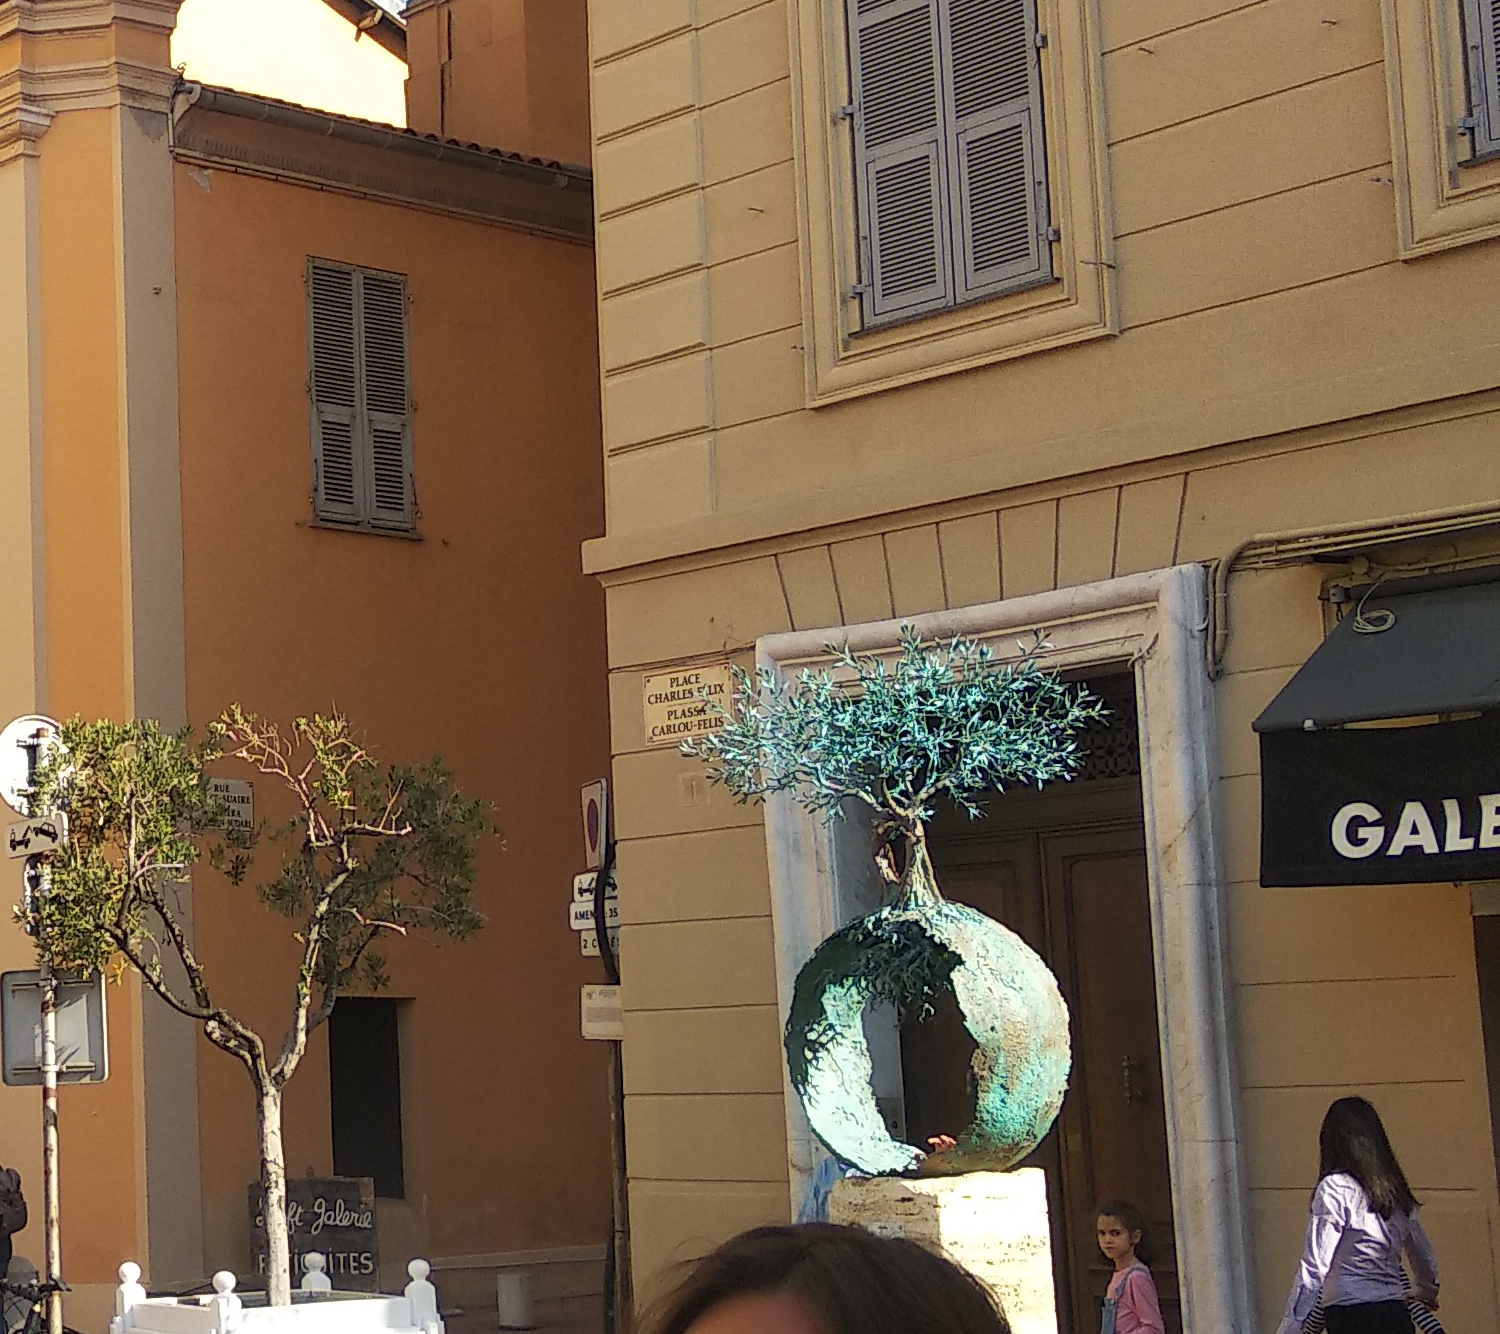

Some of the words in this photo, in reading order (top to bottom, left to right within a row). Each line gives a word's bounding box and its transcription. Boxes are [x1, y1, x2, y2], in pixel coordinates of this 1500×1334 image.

[669, 673, 701, 688] PLACE
[647, 687, 694, 705] CHARLES
[651, 716, 724, 737] CARLOU-FELIS
[213, 784, 230, 793] RUE
[582, 938, 588, 949] 2
[311, 1197, 372, 1235] Galerie
